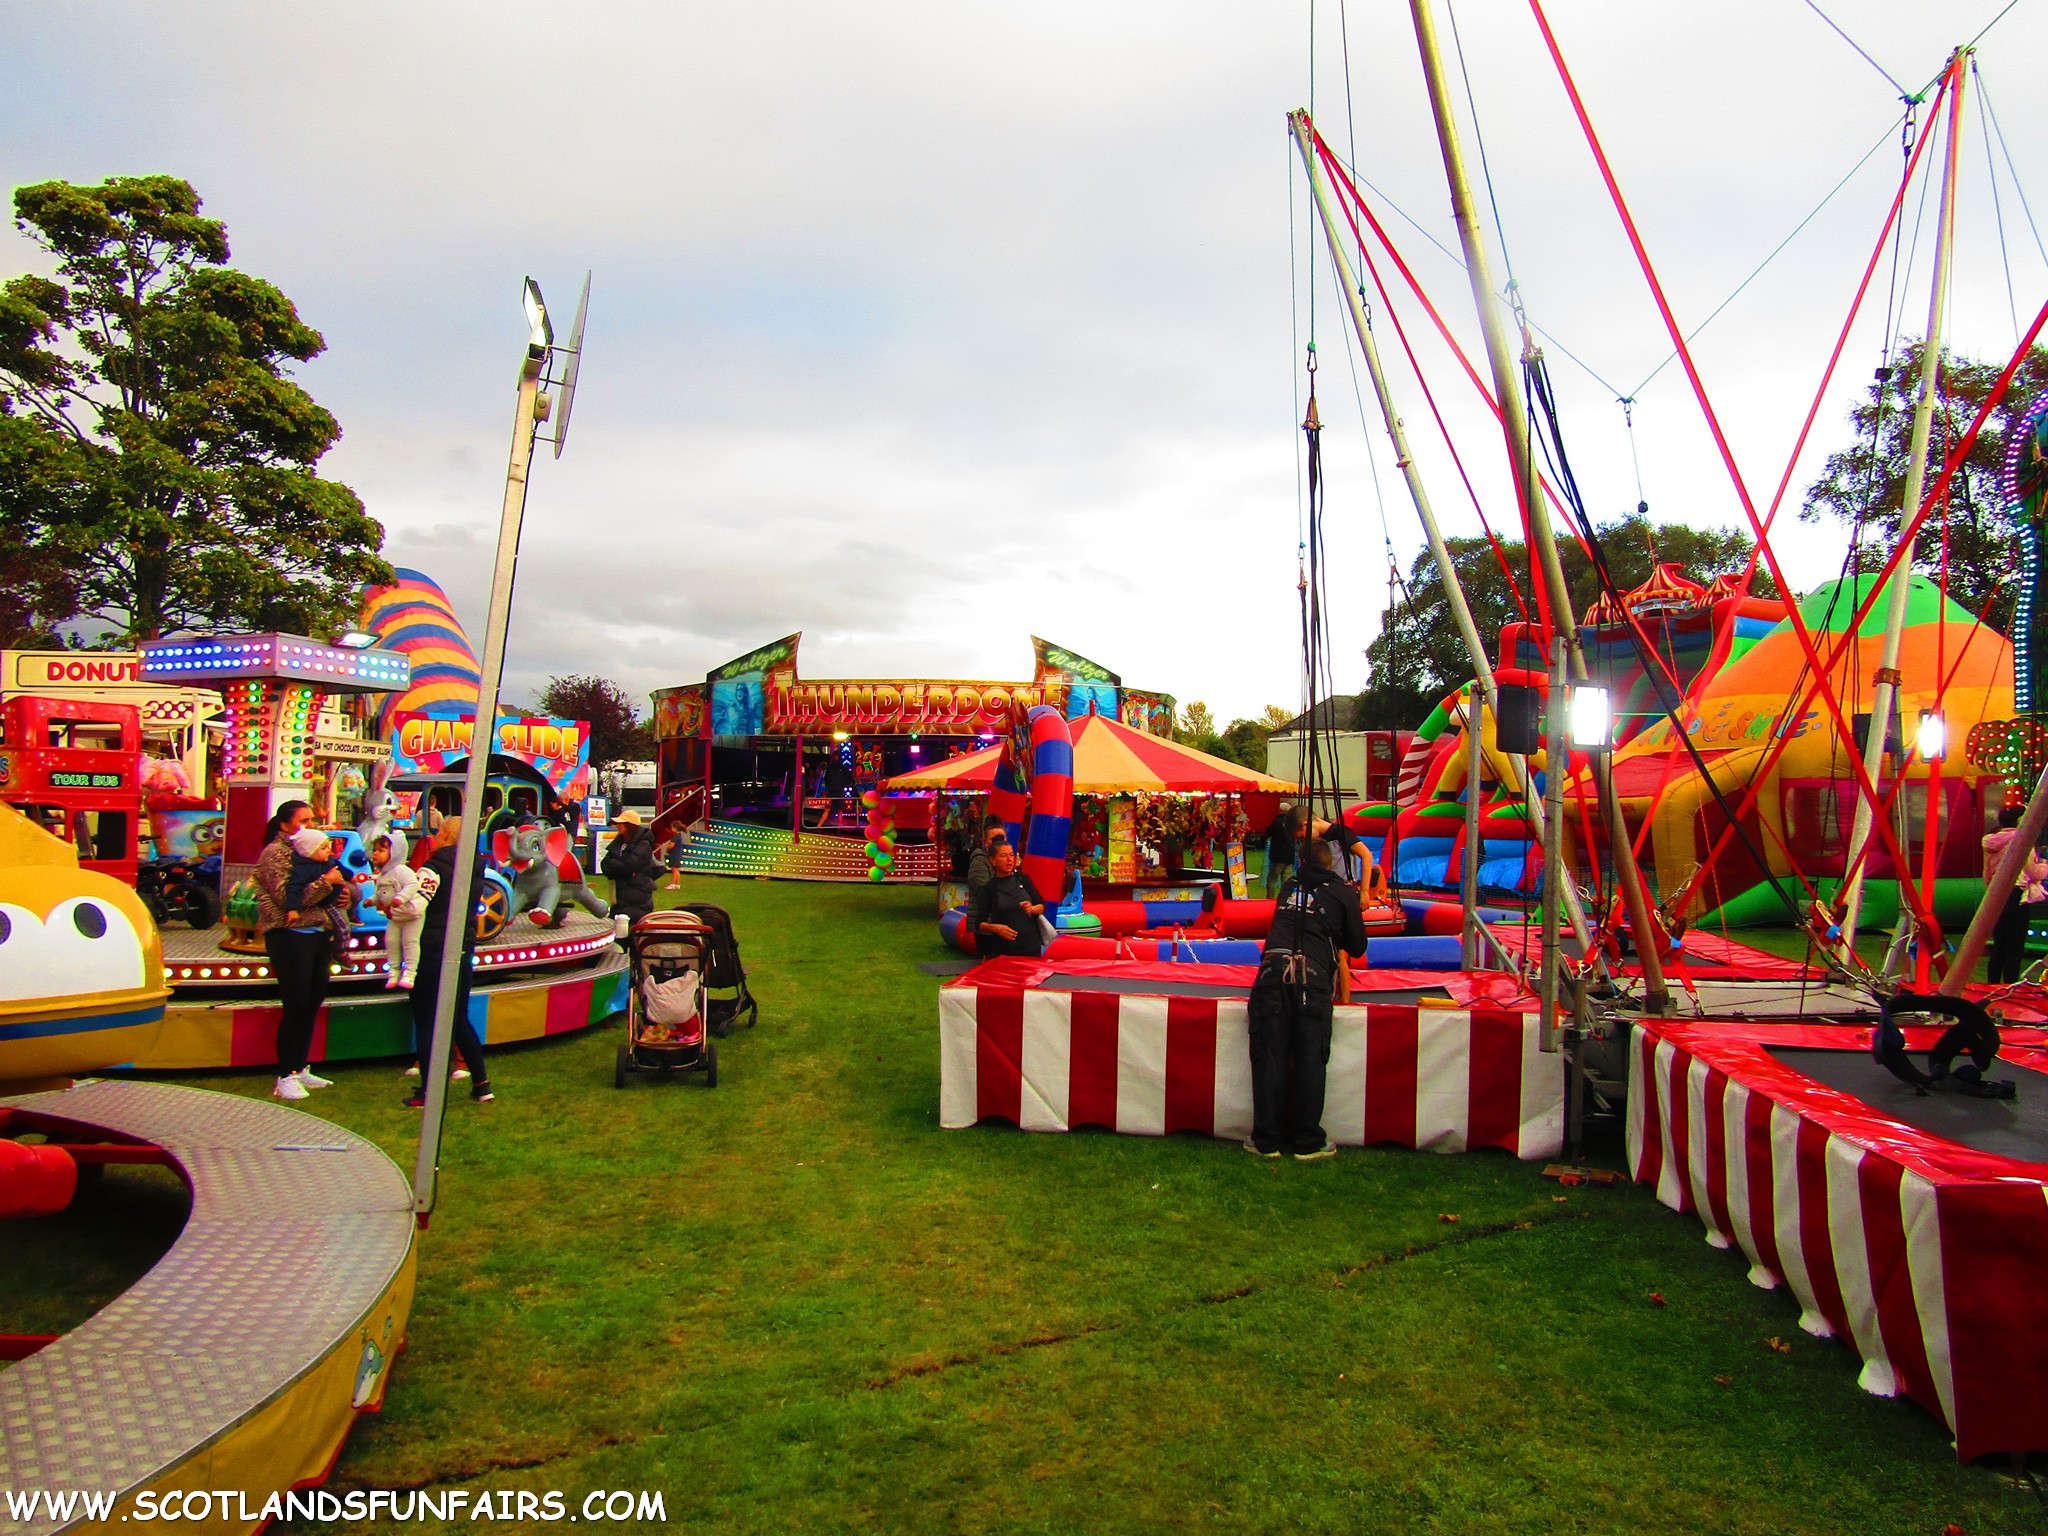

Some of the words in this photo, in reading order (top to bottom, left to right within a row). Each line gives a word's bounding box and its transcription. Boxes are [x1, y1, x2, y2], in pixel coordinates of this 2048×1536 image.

[720, 645, 788, 678] Waltzer
[1046, 651, 1109, 680] Waltzer
[767, 670, 1062, 726] THUNDERDOME
[323, 742, 334, 751] HOT
[334, 743, 360, 753] CHOCOLATE
[361, 745, 377, 754] COFFEE
[400, 718, 475, 758] GIAN
[499, 723, 581, 767] SLIDE
[52, 773, 90, 786] TOUR
[92, 775, 119, 787] BUS
